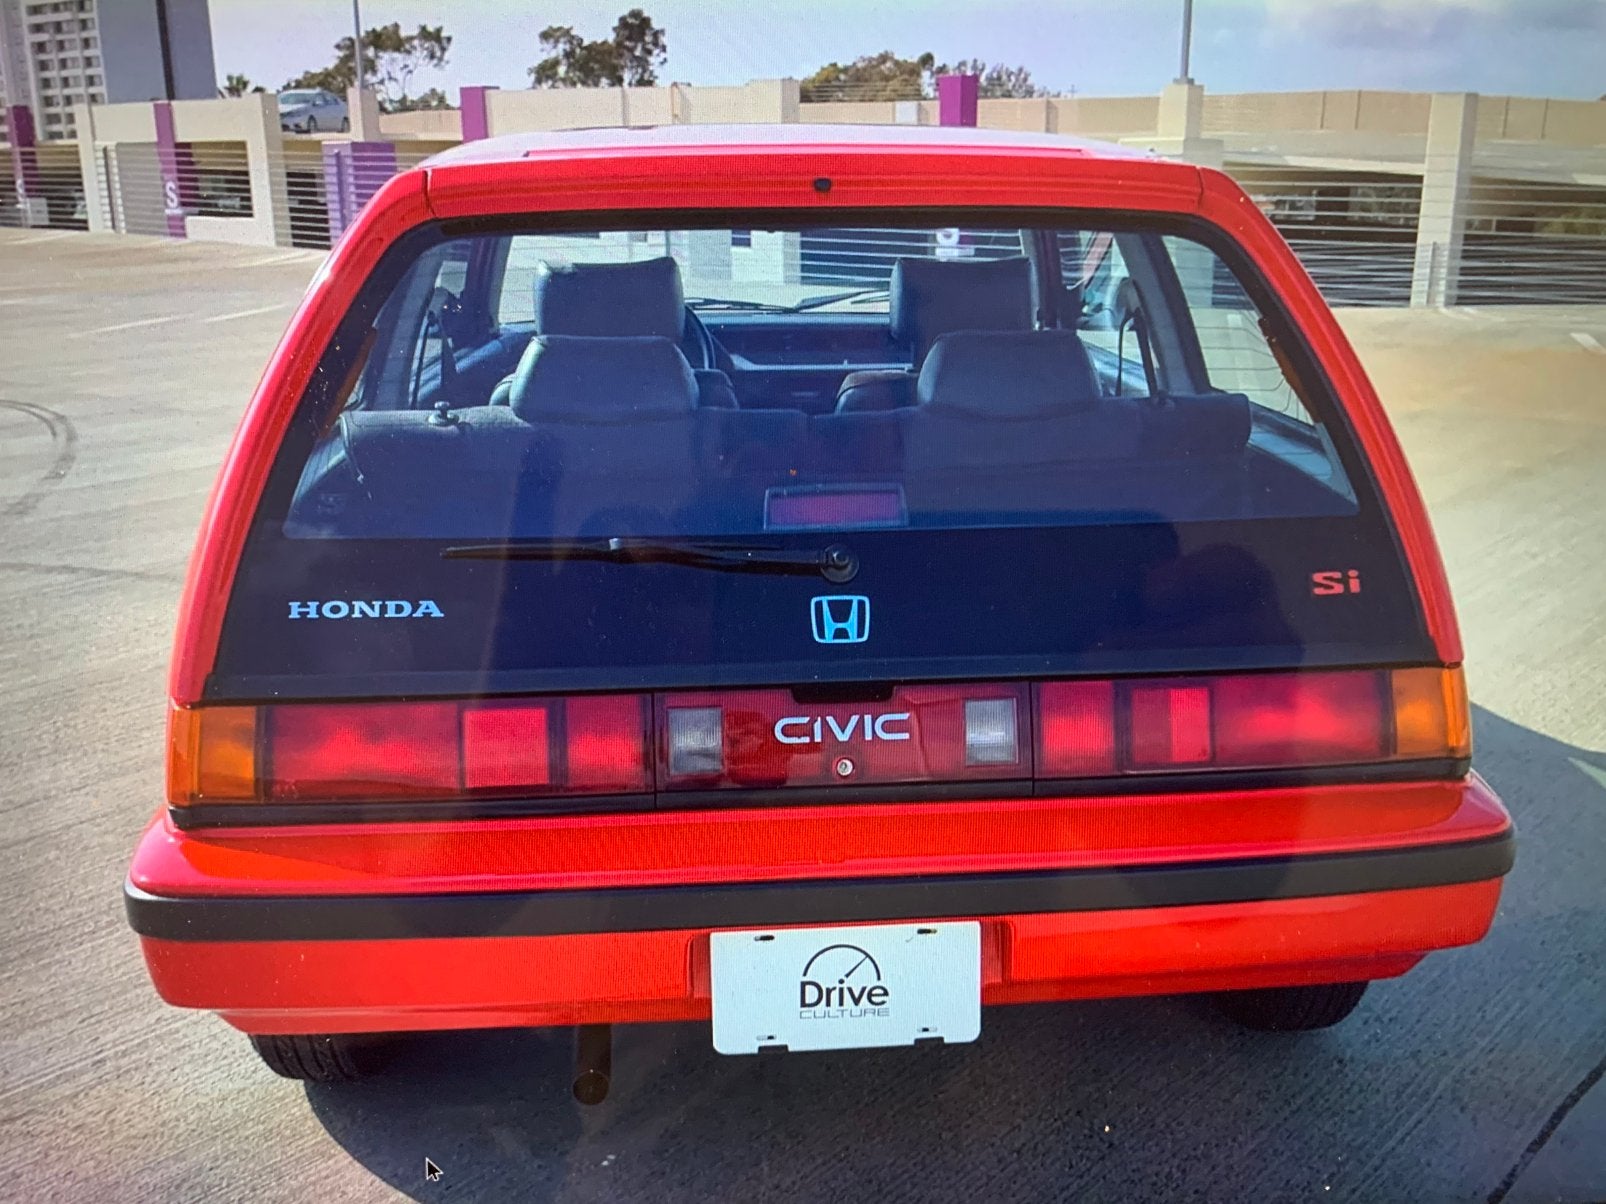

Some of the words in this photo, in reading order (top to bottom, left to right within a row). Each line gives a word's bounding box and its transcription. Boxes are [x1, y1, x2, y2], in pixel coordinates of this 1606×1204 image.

[1312, 569, 1361, 595] Si
[288, 600, 445, 619] HONDA
[774, 712, 910, 744] CIVIC
[800, 978, 889, 1008] Drive
[799, 1007, 890, 1019] CULTURE
